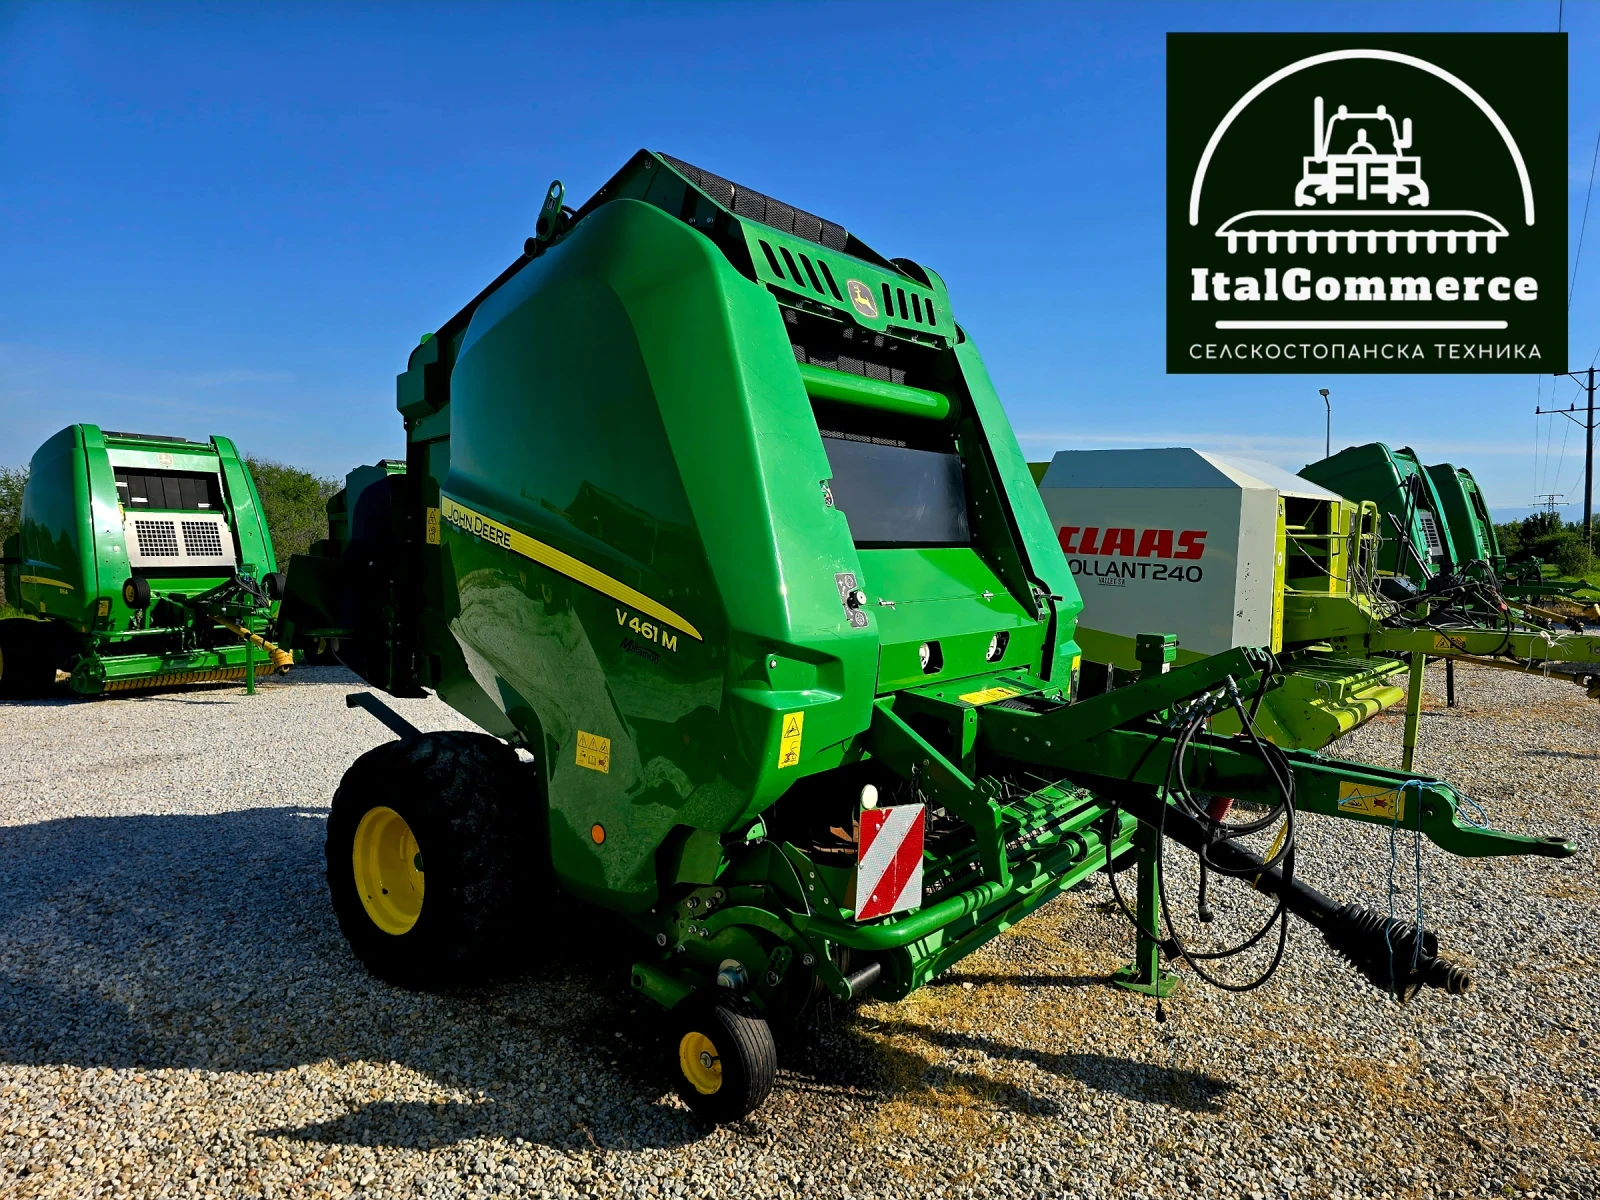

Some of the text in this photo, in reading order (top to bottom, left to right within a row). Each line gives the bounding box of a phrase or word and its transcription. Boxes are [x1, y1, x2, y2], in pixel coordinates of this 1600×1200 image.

[447, 504, 512, 549] JOHN DEERE
[1057, 526, 1208, 560] CLAAS
[615, 607, 678, 653] V 461 M
